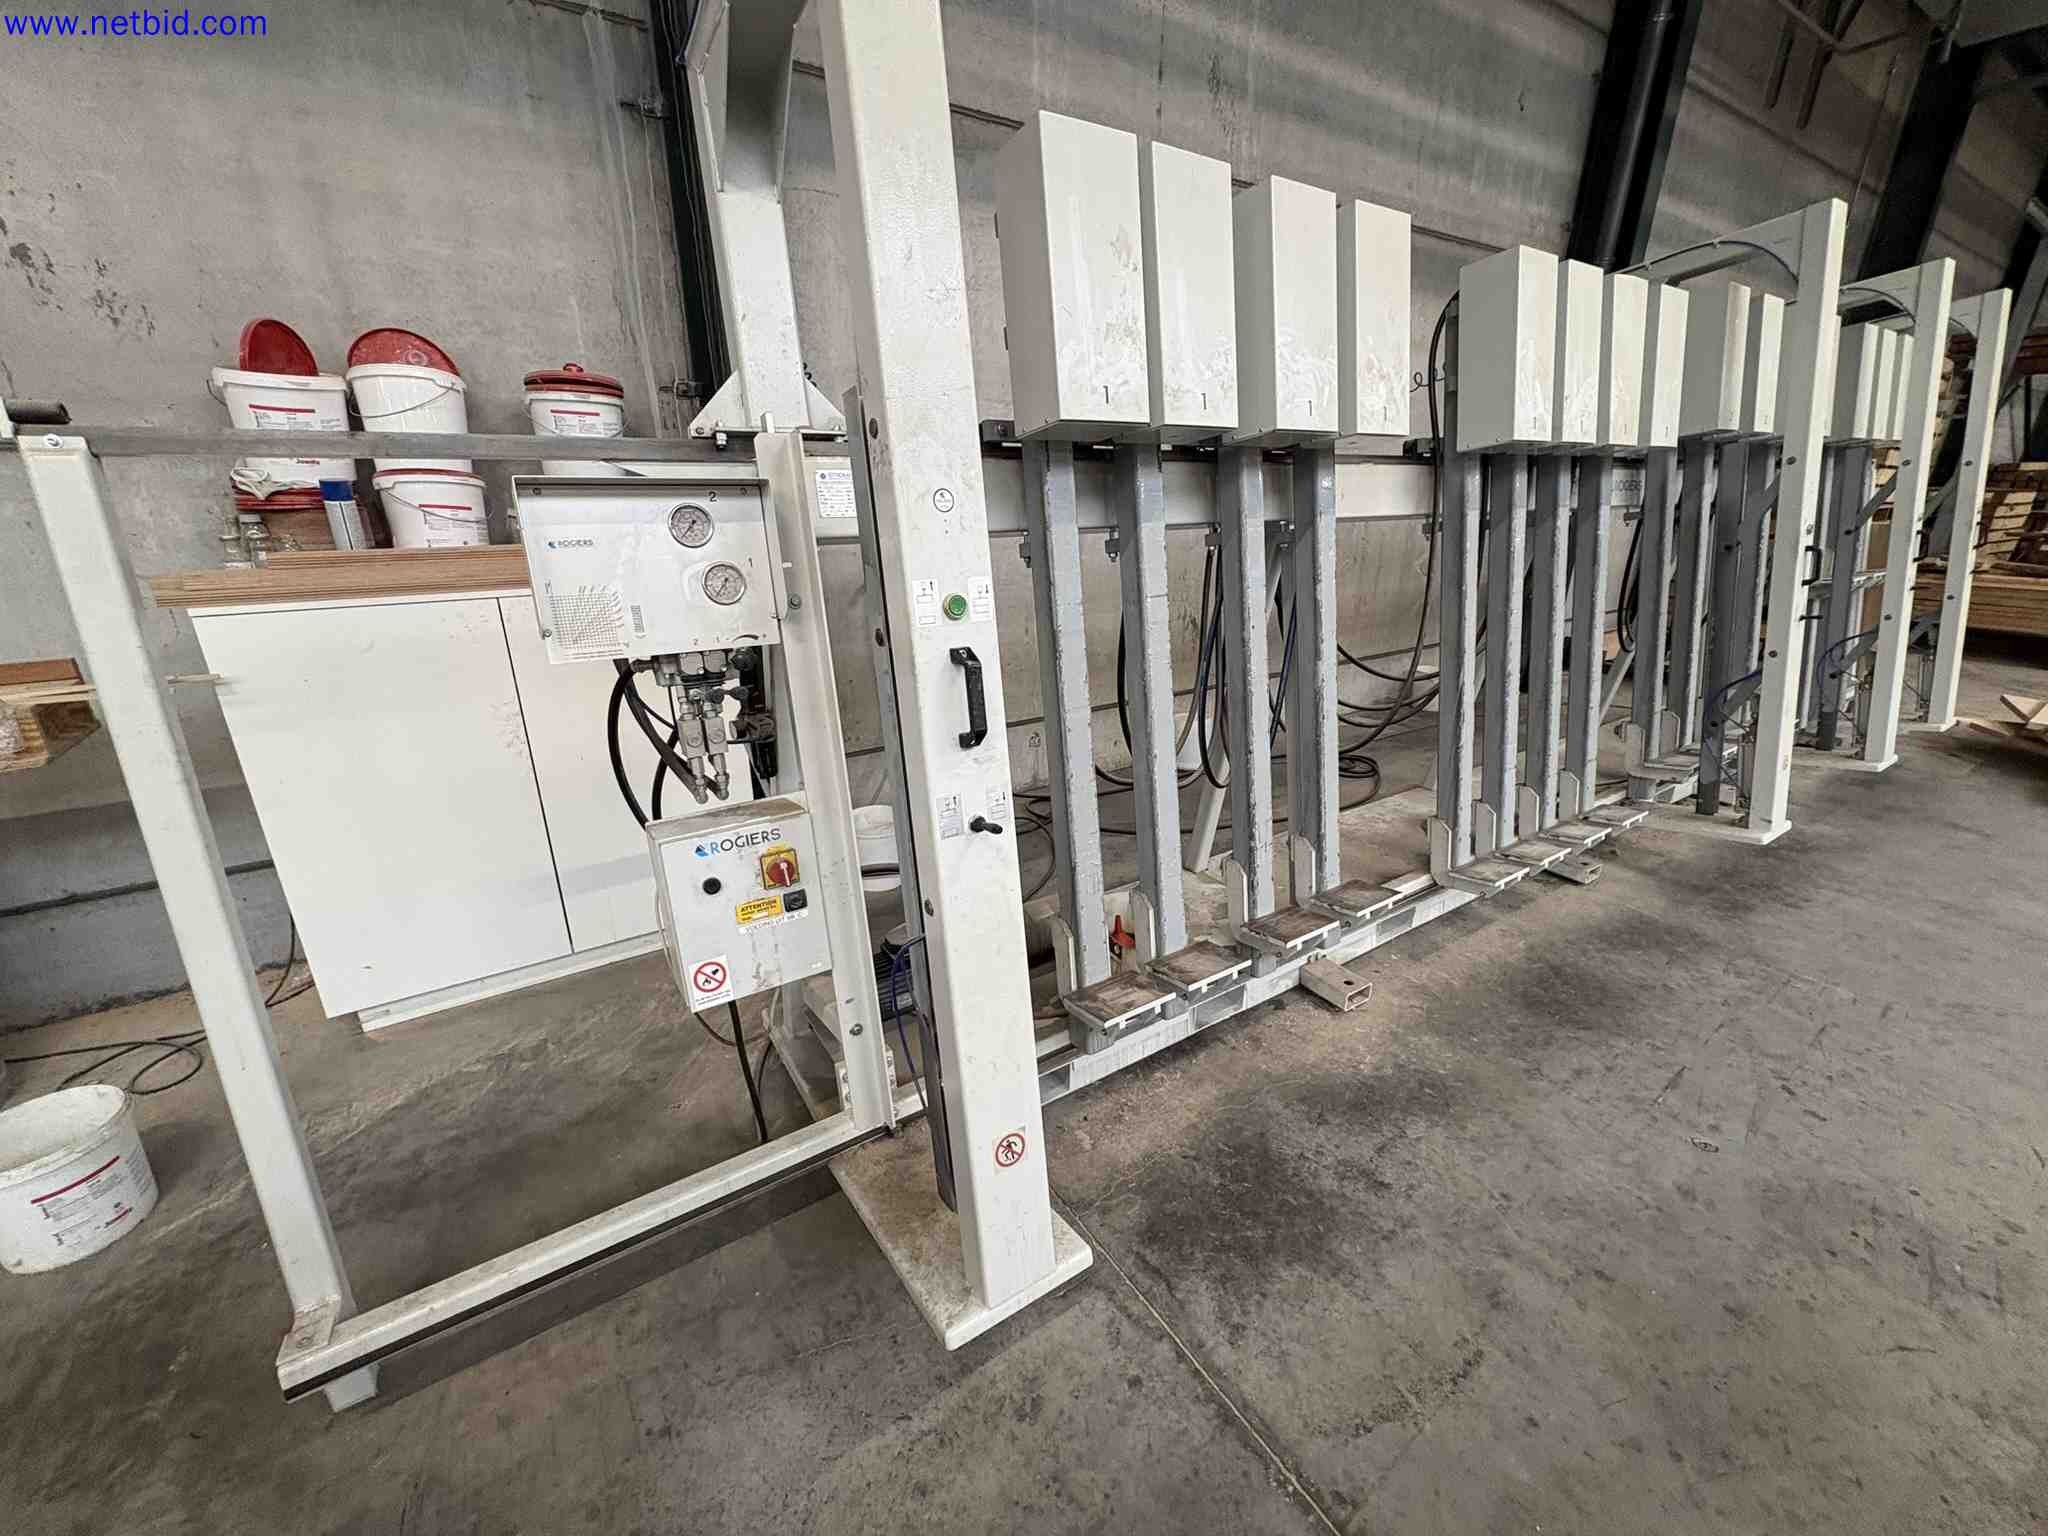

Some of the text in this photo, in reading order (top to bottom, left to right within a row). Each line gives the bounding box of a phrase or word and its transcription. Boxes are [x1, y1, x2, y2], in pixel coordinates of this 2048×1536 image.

[1103, 384, 1110, 404] 1
[1201, 392, 1208, 410] 1
[708, 490, 718, 503] 2
[710, 828, 781, 854] ROGIERS
